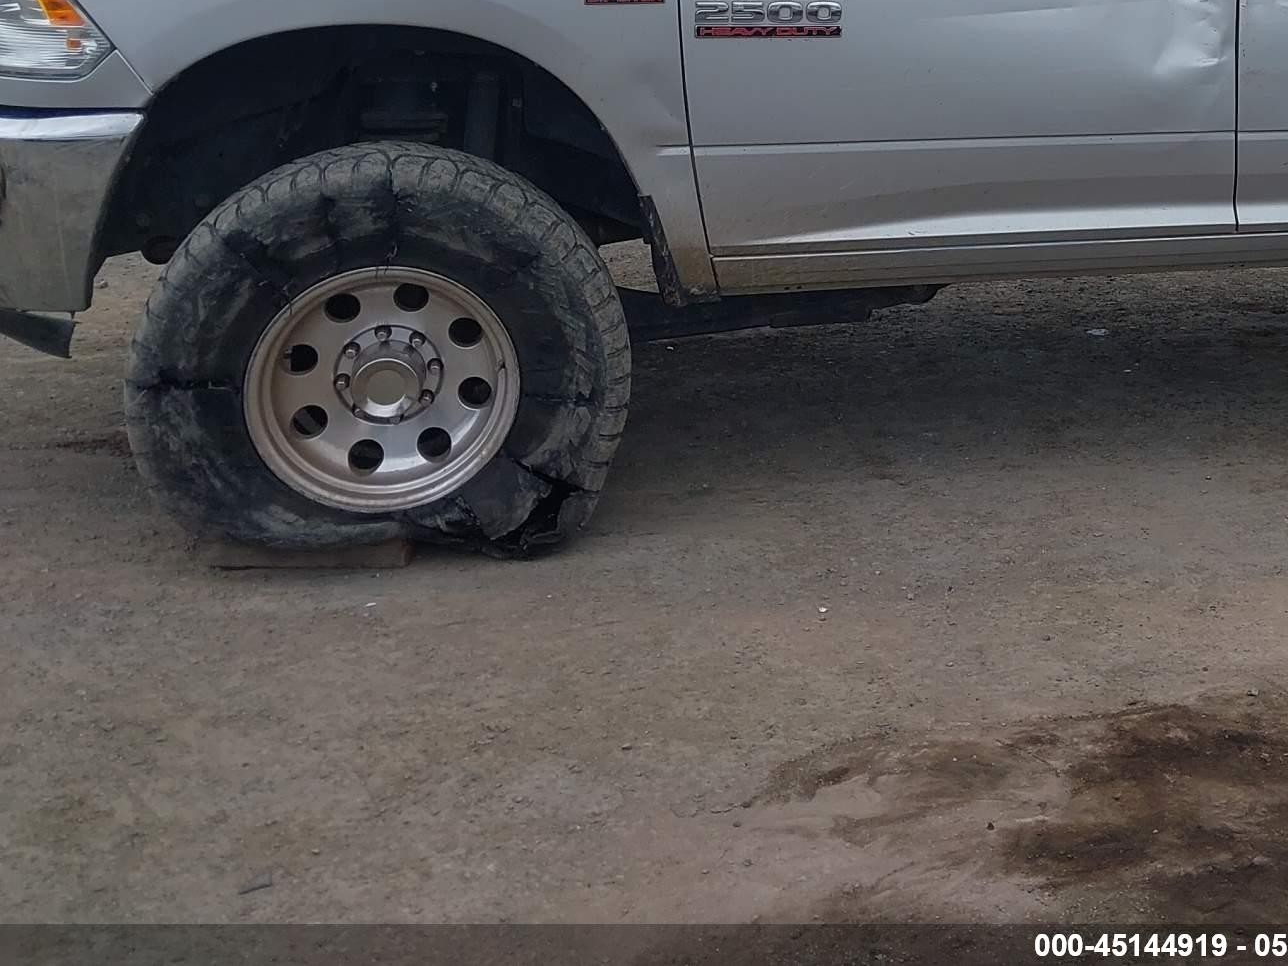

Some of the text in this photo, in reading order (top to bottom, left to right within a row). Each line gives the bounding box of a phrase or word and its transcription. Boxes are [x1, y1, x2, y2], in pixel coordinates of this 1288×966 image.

[695, 1, 842, 23] 2500
[700, 26, 838, 36] HEAVY DUTY
